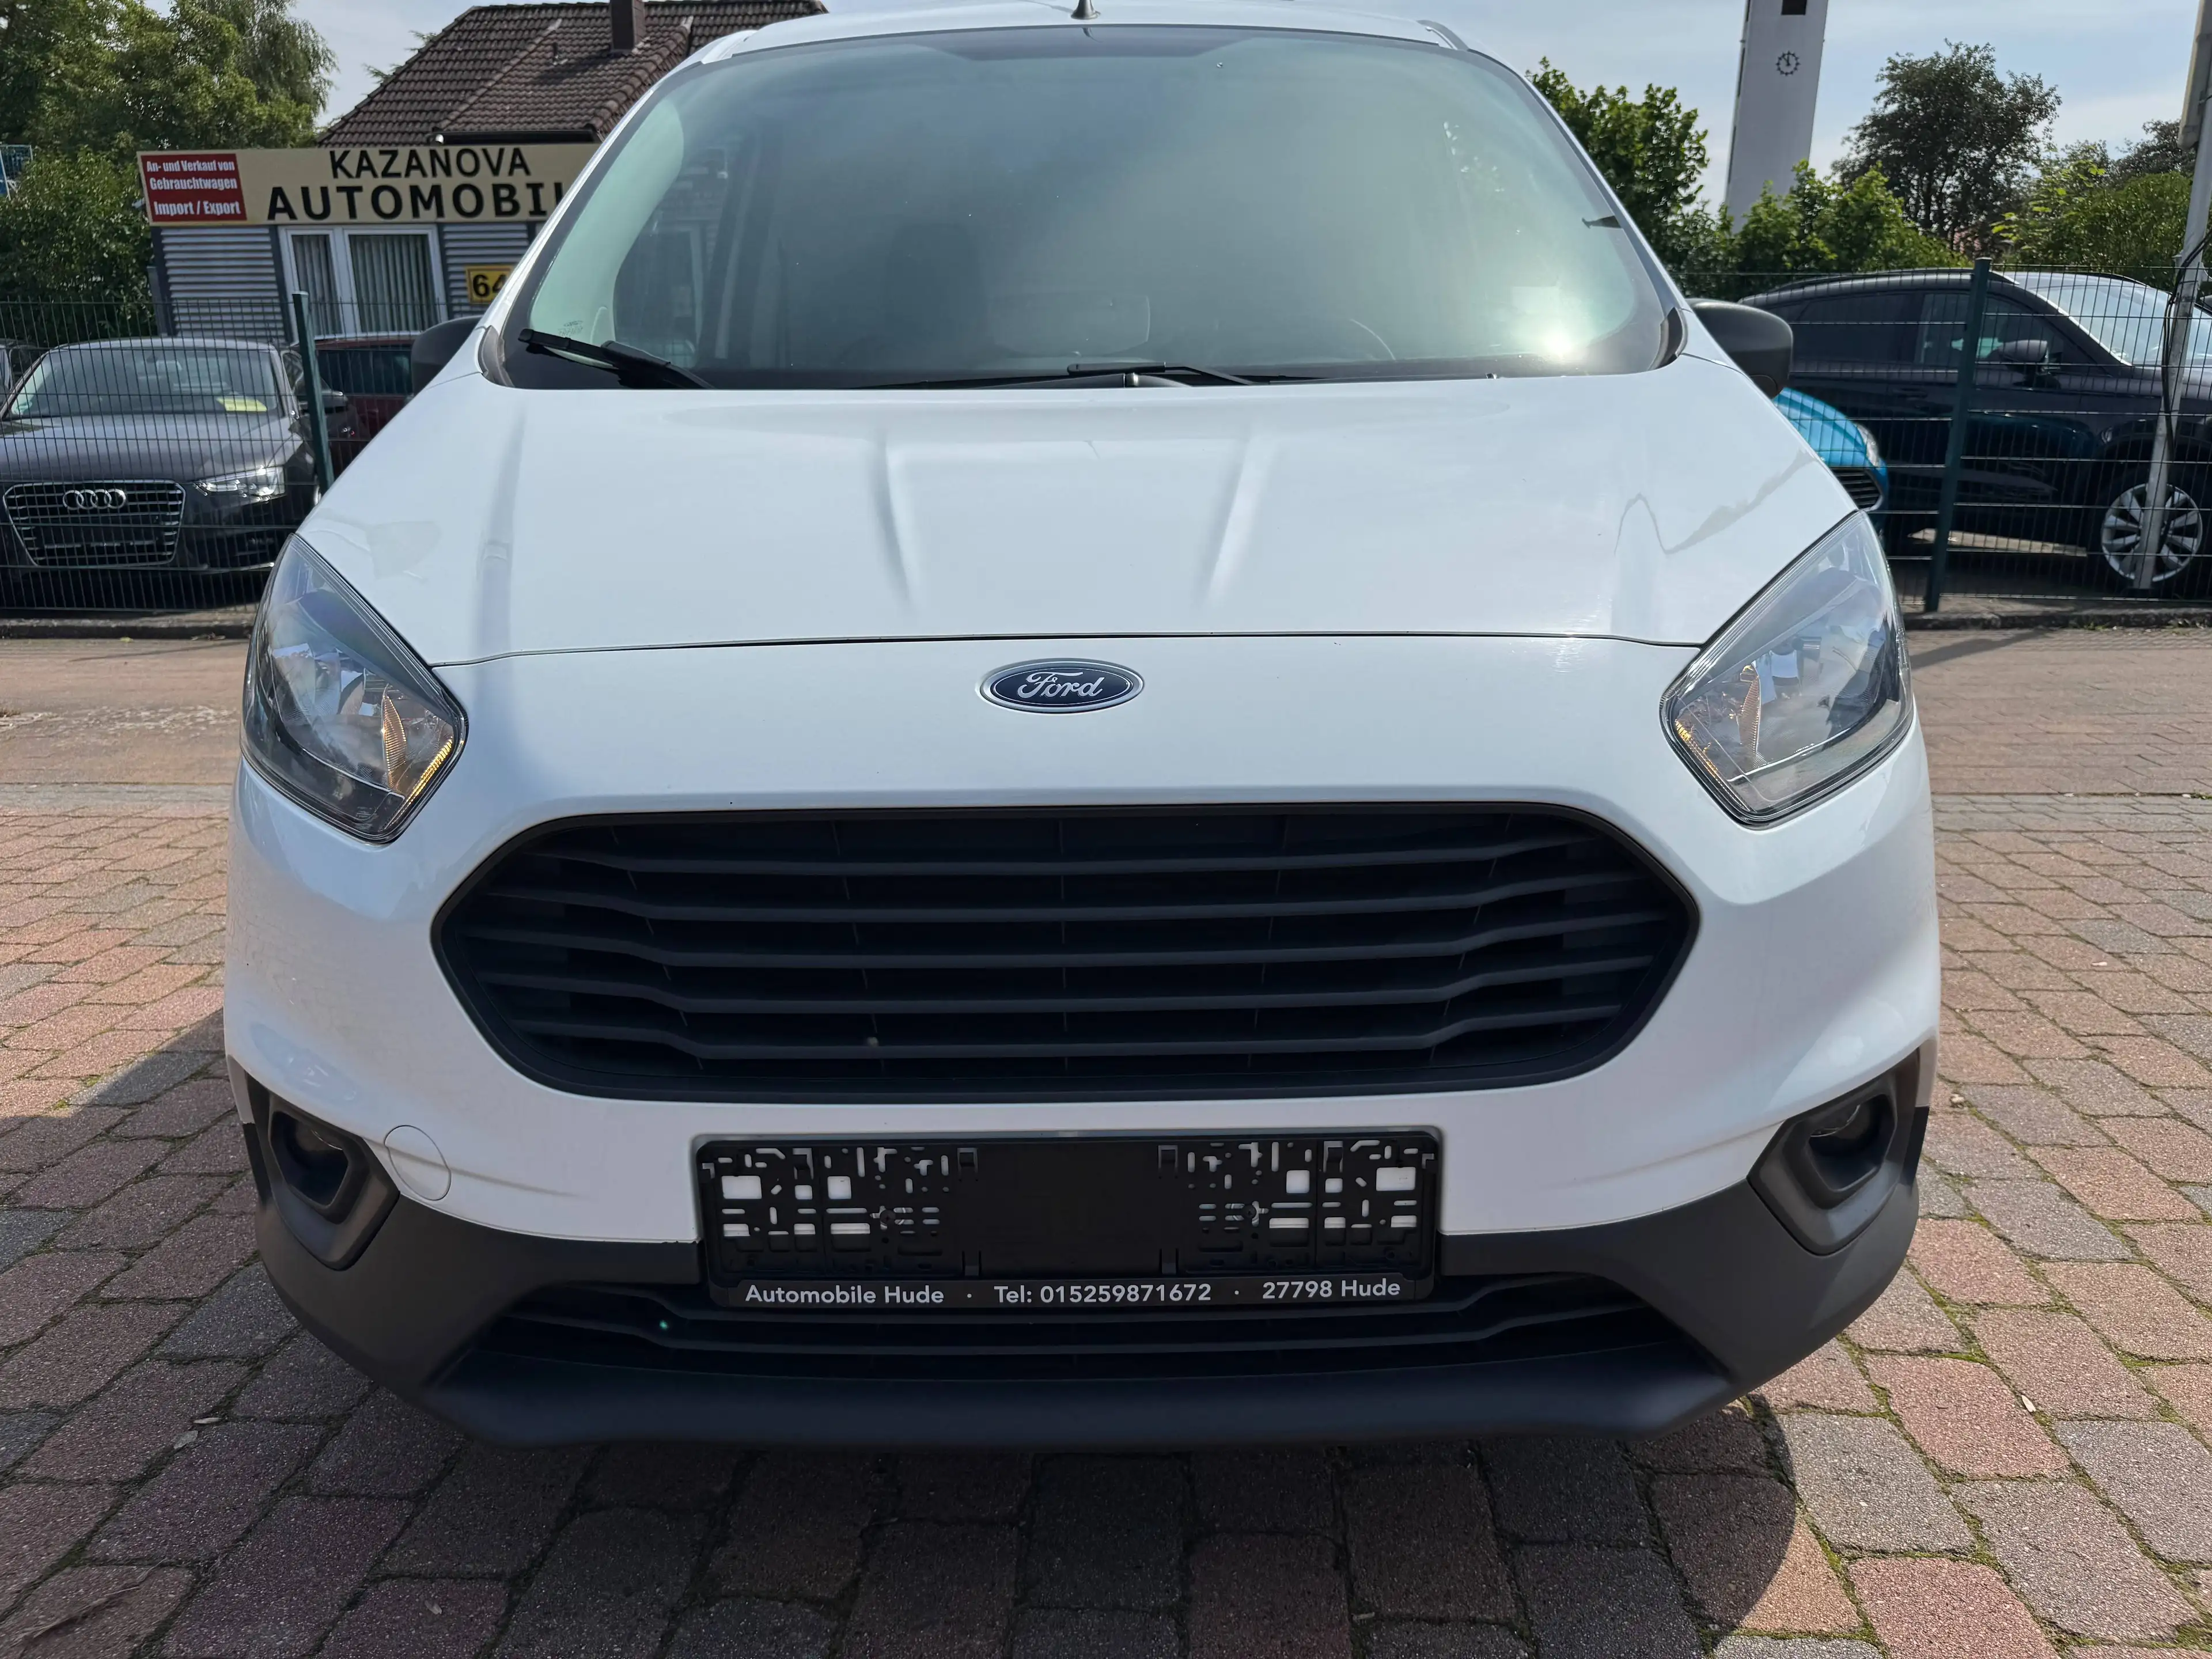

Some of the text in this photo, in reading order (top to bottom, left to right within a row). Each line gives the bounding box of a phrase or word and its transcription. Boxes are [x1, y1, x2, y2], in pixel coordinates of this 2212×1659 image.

[146, 160, 236, 172] An- und Verkauf von
[329, 147, 531, 179] KAZANOVA
[149, 177, 238, 191] Gebrauchtwagen
[153, 200, 195, 216] Import
[203, 200, 241, 215] Export
[473, 274, 507, 297] 64
[1017, 671, 1105, 699] Ford
[745, 1278, 1400, 1304] Automobile Hude Tel: 015259871672 27798 Hude
